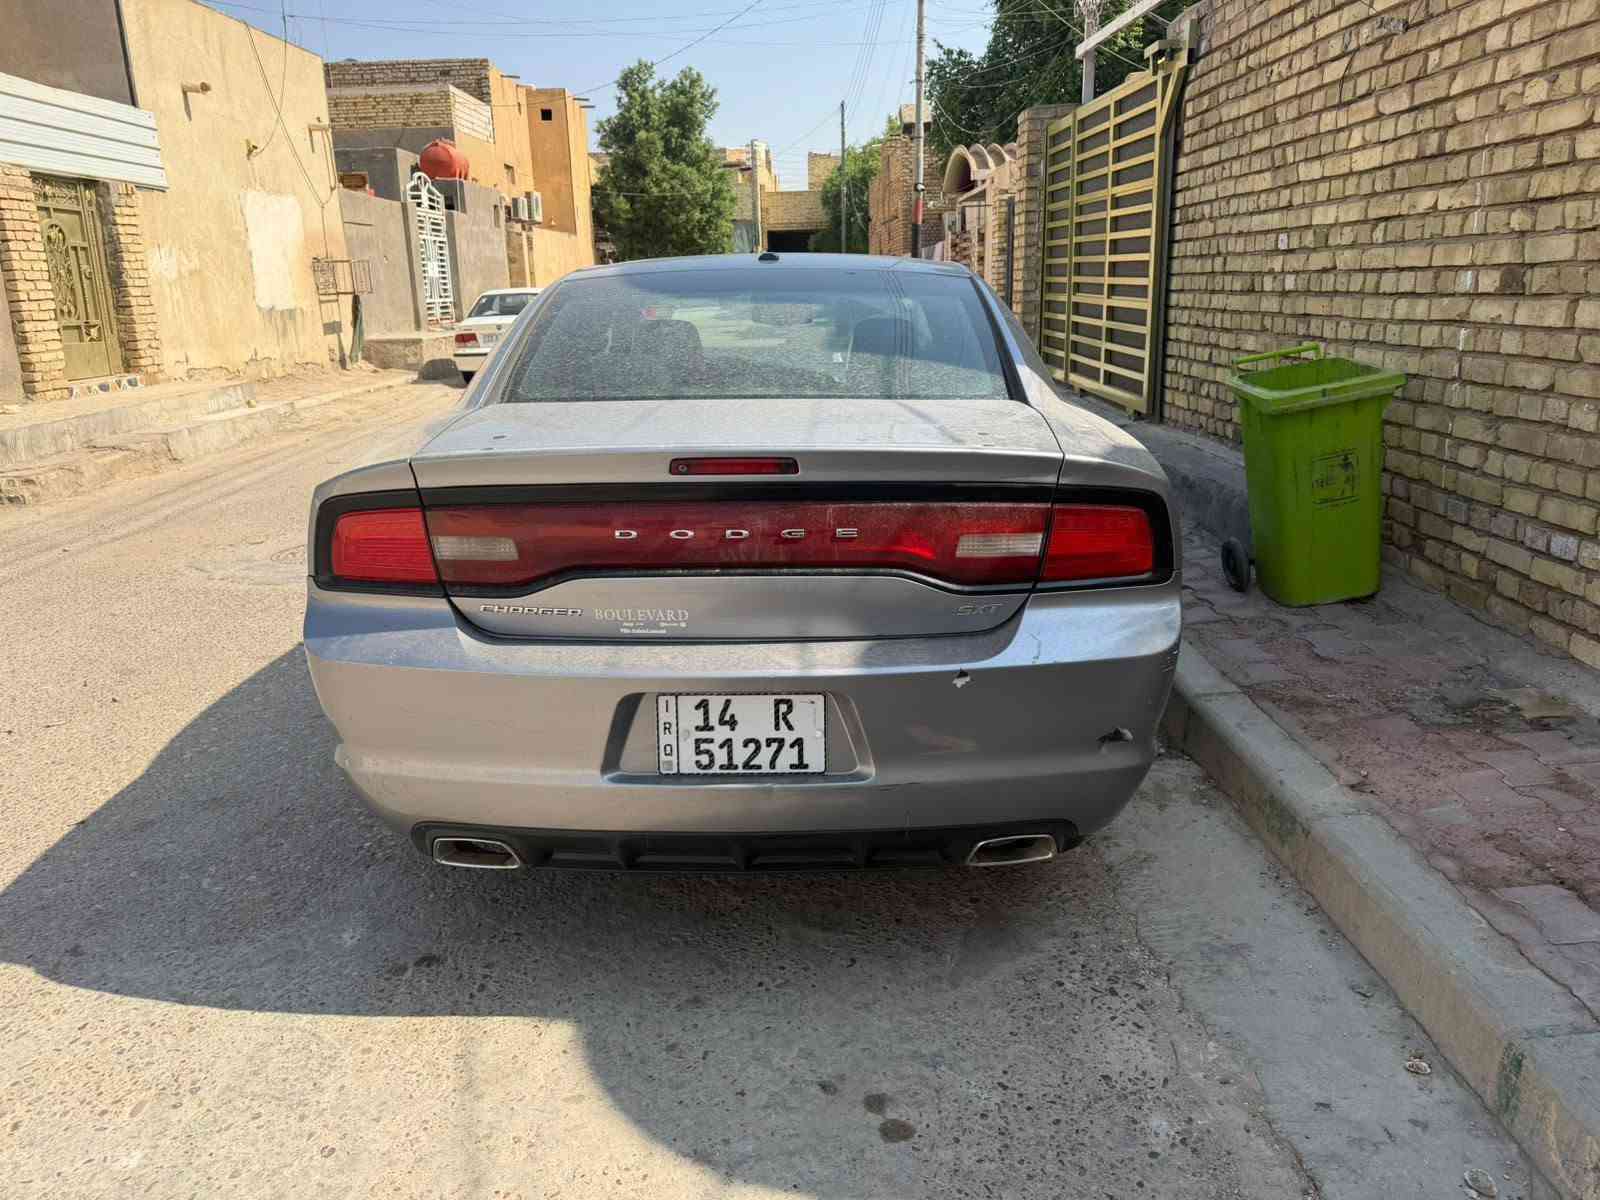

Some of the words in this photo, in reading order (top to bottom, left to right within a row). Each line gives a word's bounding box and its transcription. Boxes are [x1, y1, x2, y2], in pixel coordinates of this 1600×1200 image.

[614, 528, 859, 540] DODGE
[480, 604, 583, 616] CHARGER
[594, 608, 688, 621] BOULEVARD
[694, 698, 739, 732] 14
[773, 698, 795, 732] R
[663, 698, 674, 758] IRQ
[694, 737, 810, 770] 51271
